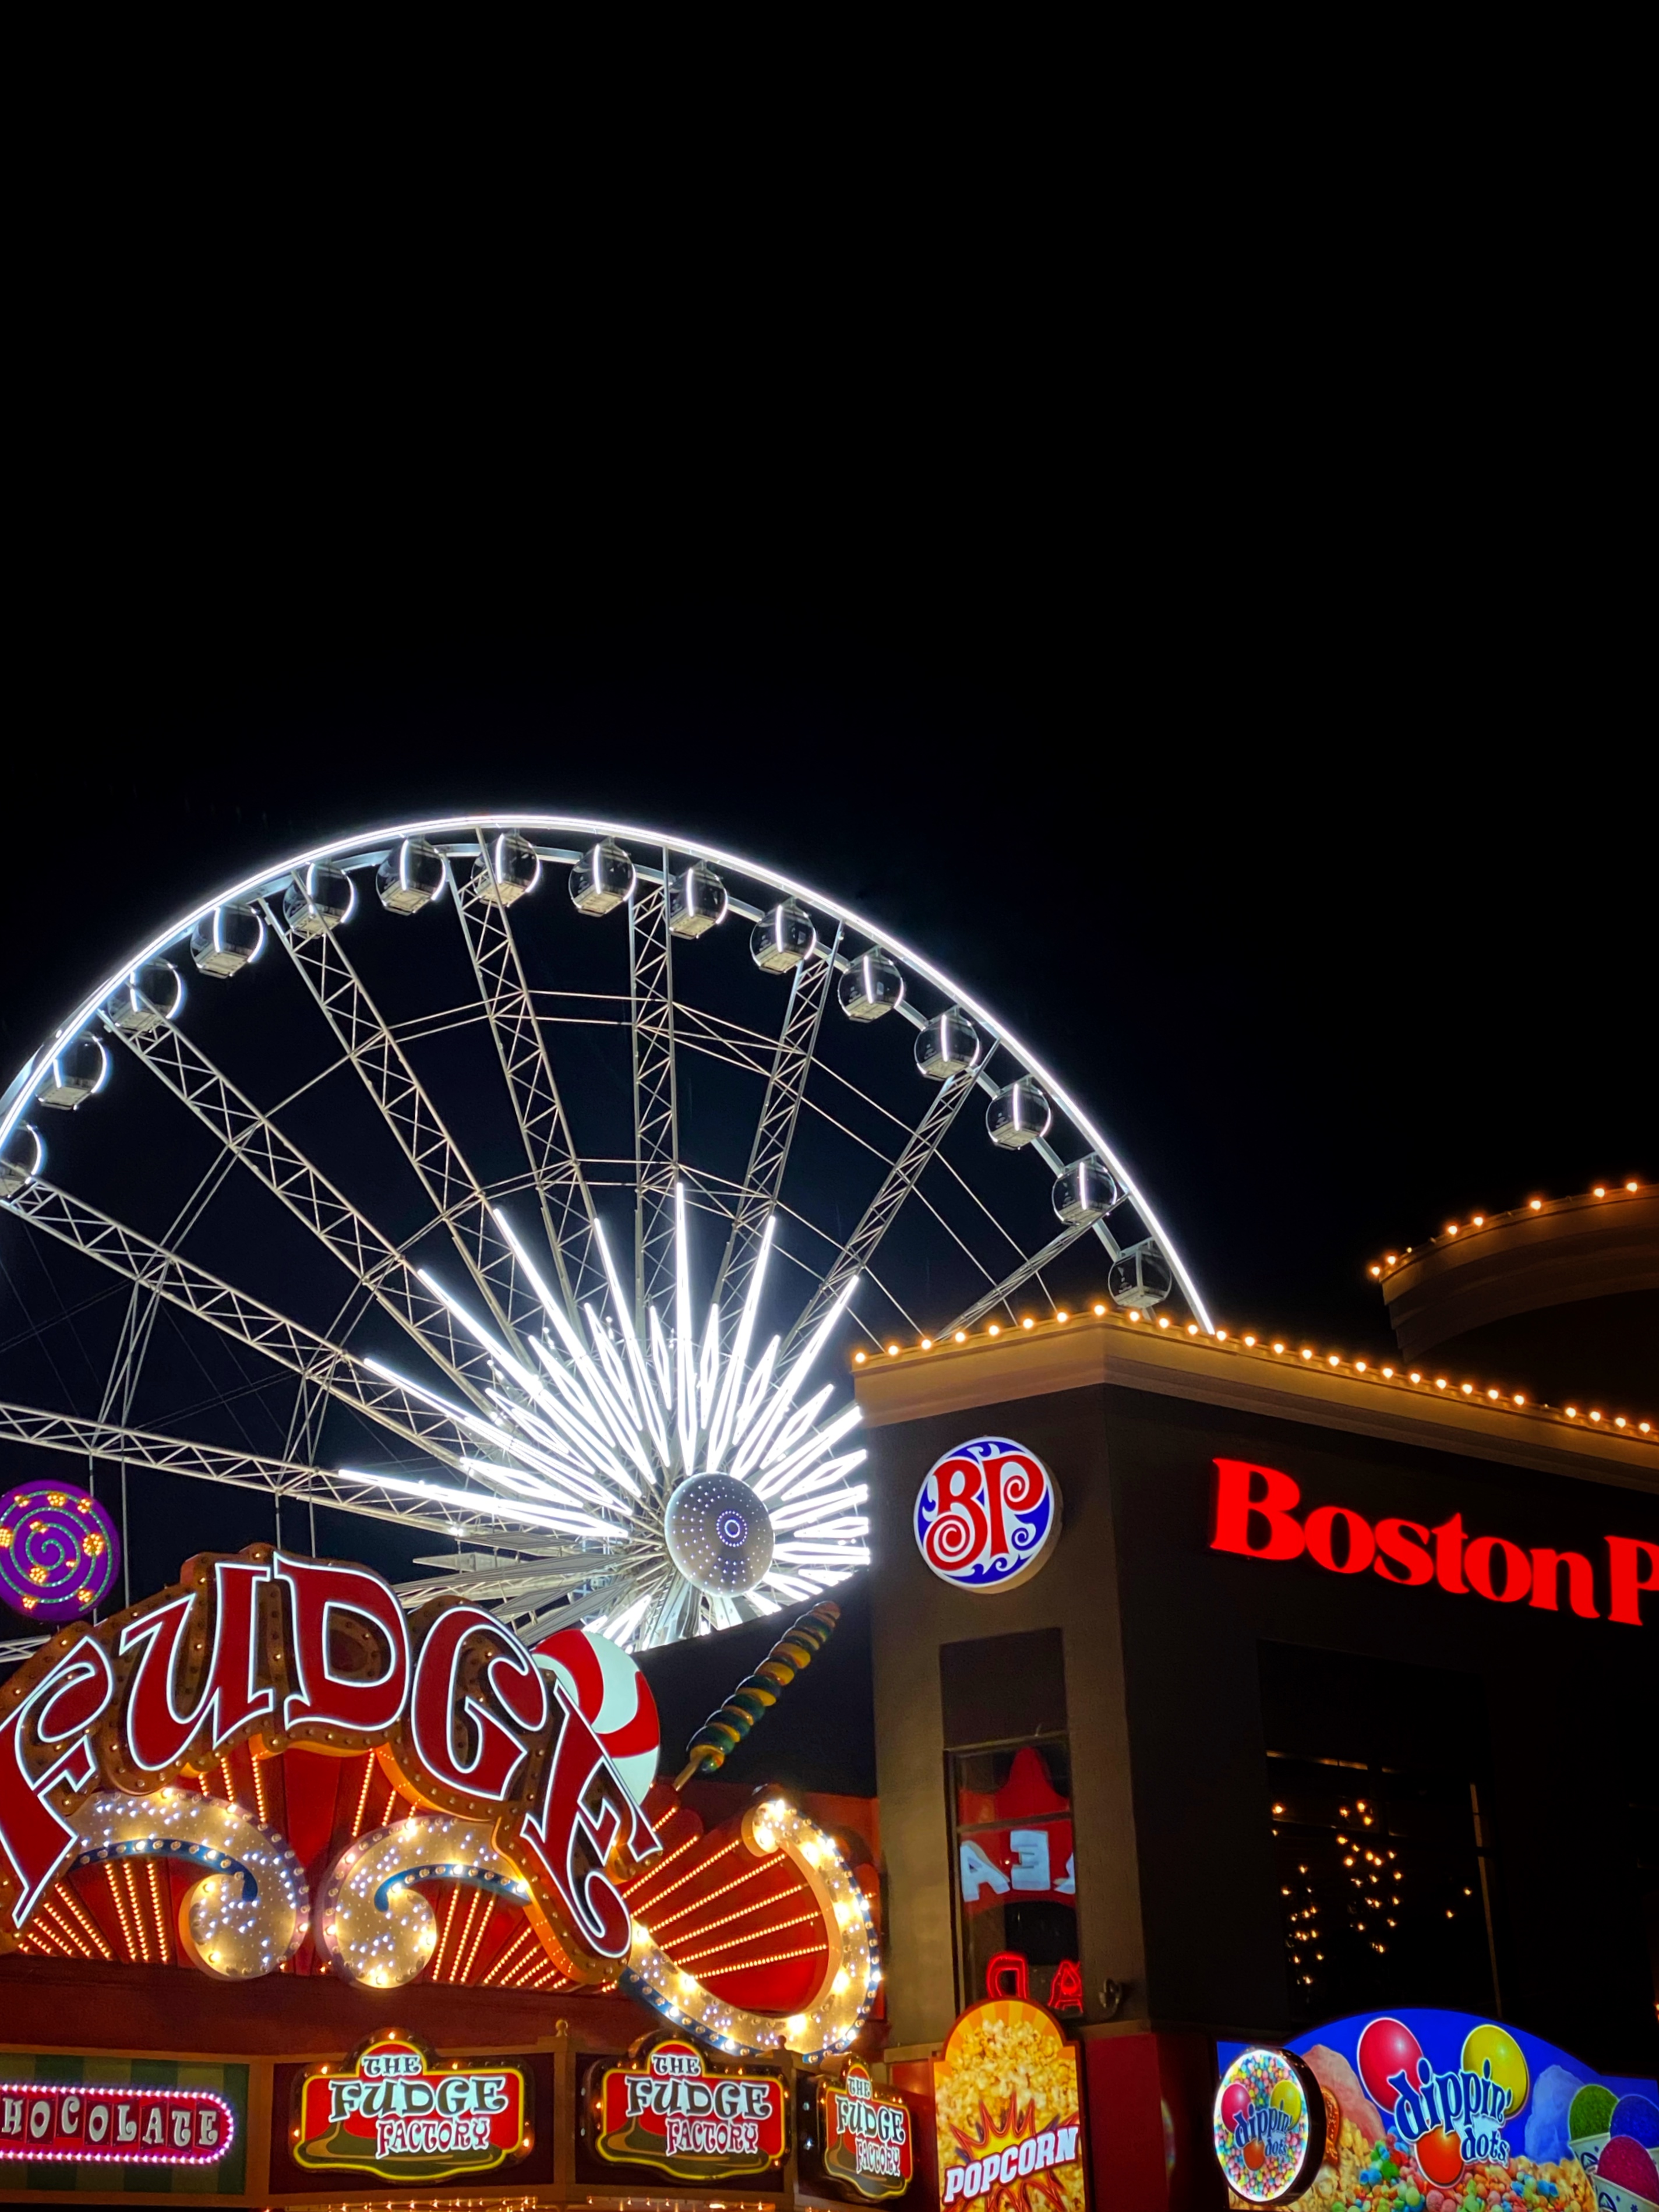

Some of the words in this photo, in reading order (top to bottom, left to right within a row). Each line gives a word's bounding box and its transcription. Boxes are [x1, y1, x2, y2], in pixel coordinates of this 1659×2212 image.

[926, 1454, 1045, 1571] BP
[1210, 1458, 1601, 1619] Boston
[0, 1550, 663, 1959] FUDGE
[362, 2054, 422, 2077] THE
[652, 2054, 701, 2076] THE
[329, 2075, 509, 2122] FUDGE
[625, 2075, 772, 2120] FUDGE
[848, 2076, 871, 2100] THE
[376, 2118, 490, 2160] FACTORY
[666, 2118, 758, 2156] FACTORY
[835, 2095, 905, 2145] FUDGE
[855, 2137, 901, 2176] FACTORY
[943, 2126, 1079, 2204] POPCORN
[1265, 2138, 1288, 2157] dots
[1460, 2126, 1509, 2165] dots
